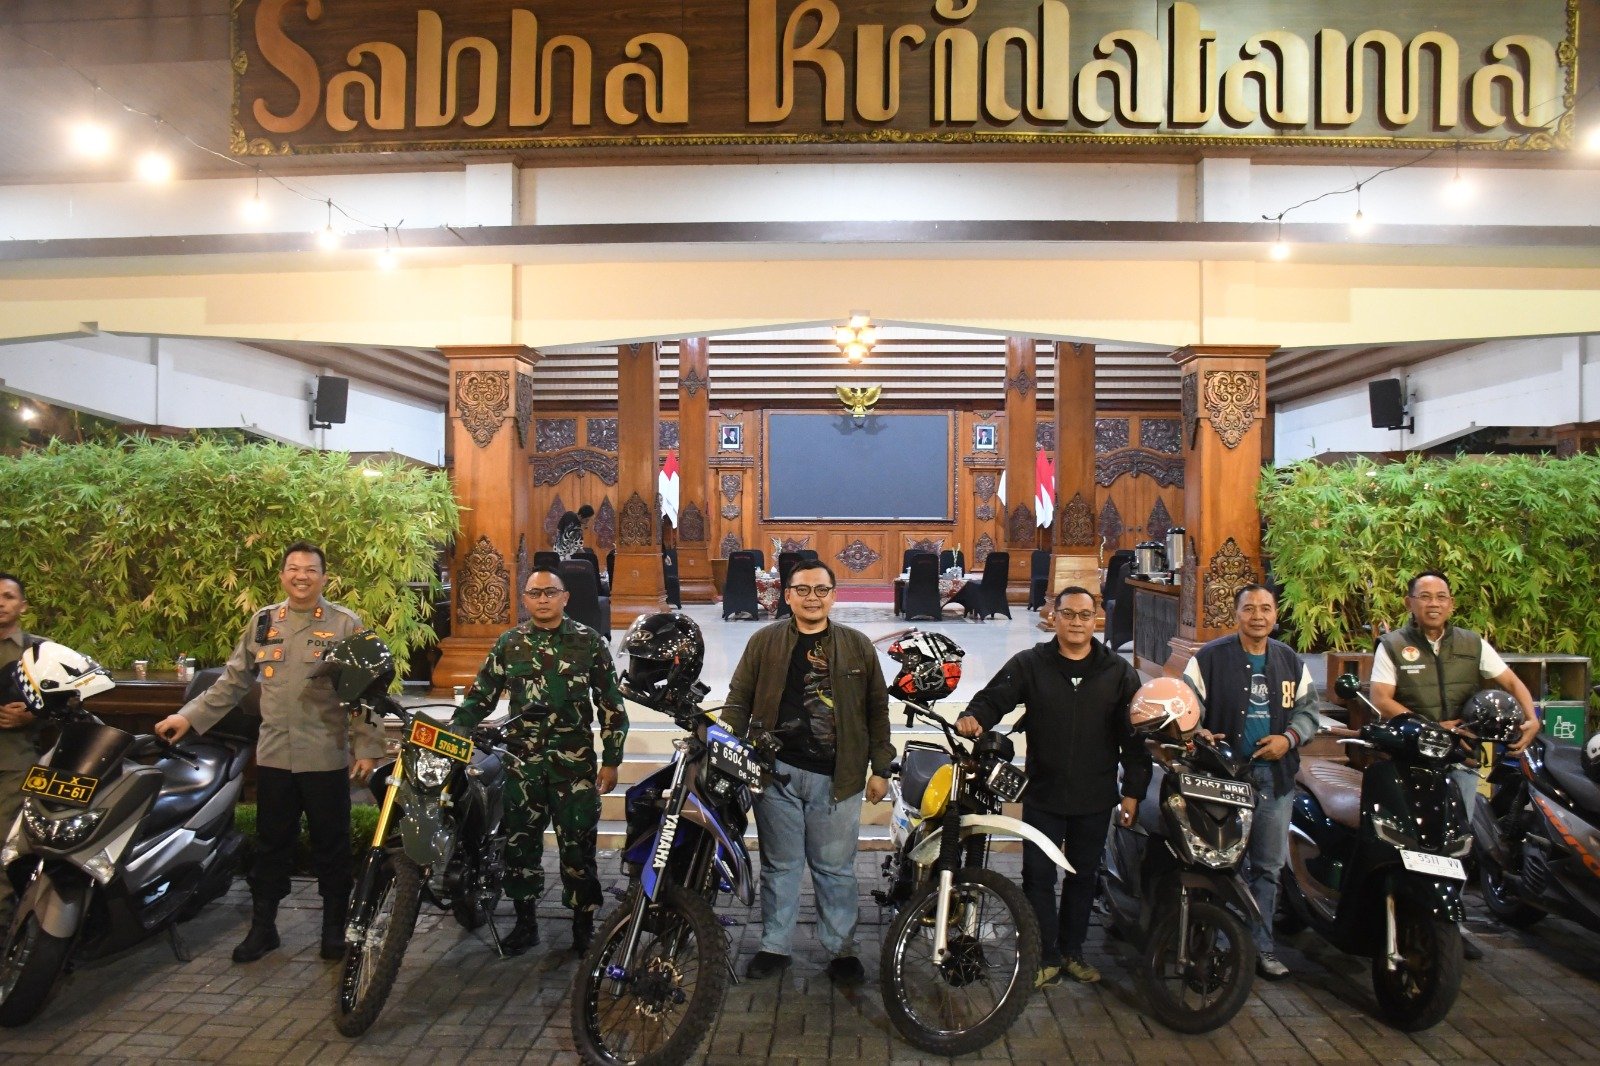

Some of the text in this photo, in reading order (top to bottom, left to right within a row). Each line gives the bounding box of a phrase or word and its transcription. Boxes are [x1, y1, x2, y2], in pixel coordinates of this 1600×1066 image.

[253, 0, 689, 133] Sabha
[713, 741, 719, 753] S
[723, 747, 742, 767] 6504
[70, 776, 80, 785] X
[1184, 776, 1192, 785] S
[57, 784, 86, 799] 1-61
[965, 782, 970, 795] H
[652, 814, 680, 868] YAMAHA
[1403, 851, 1410, 860] S
